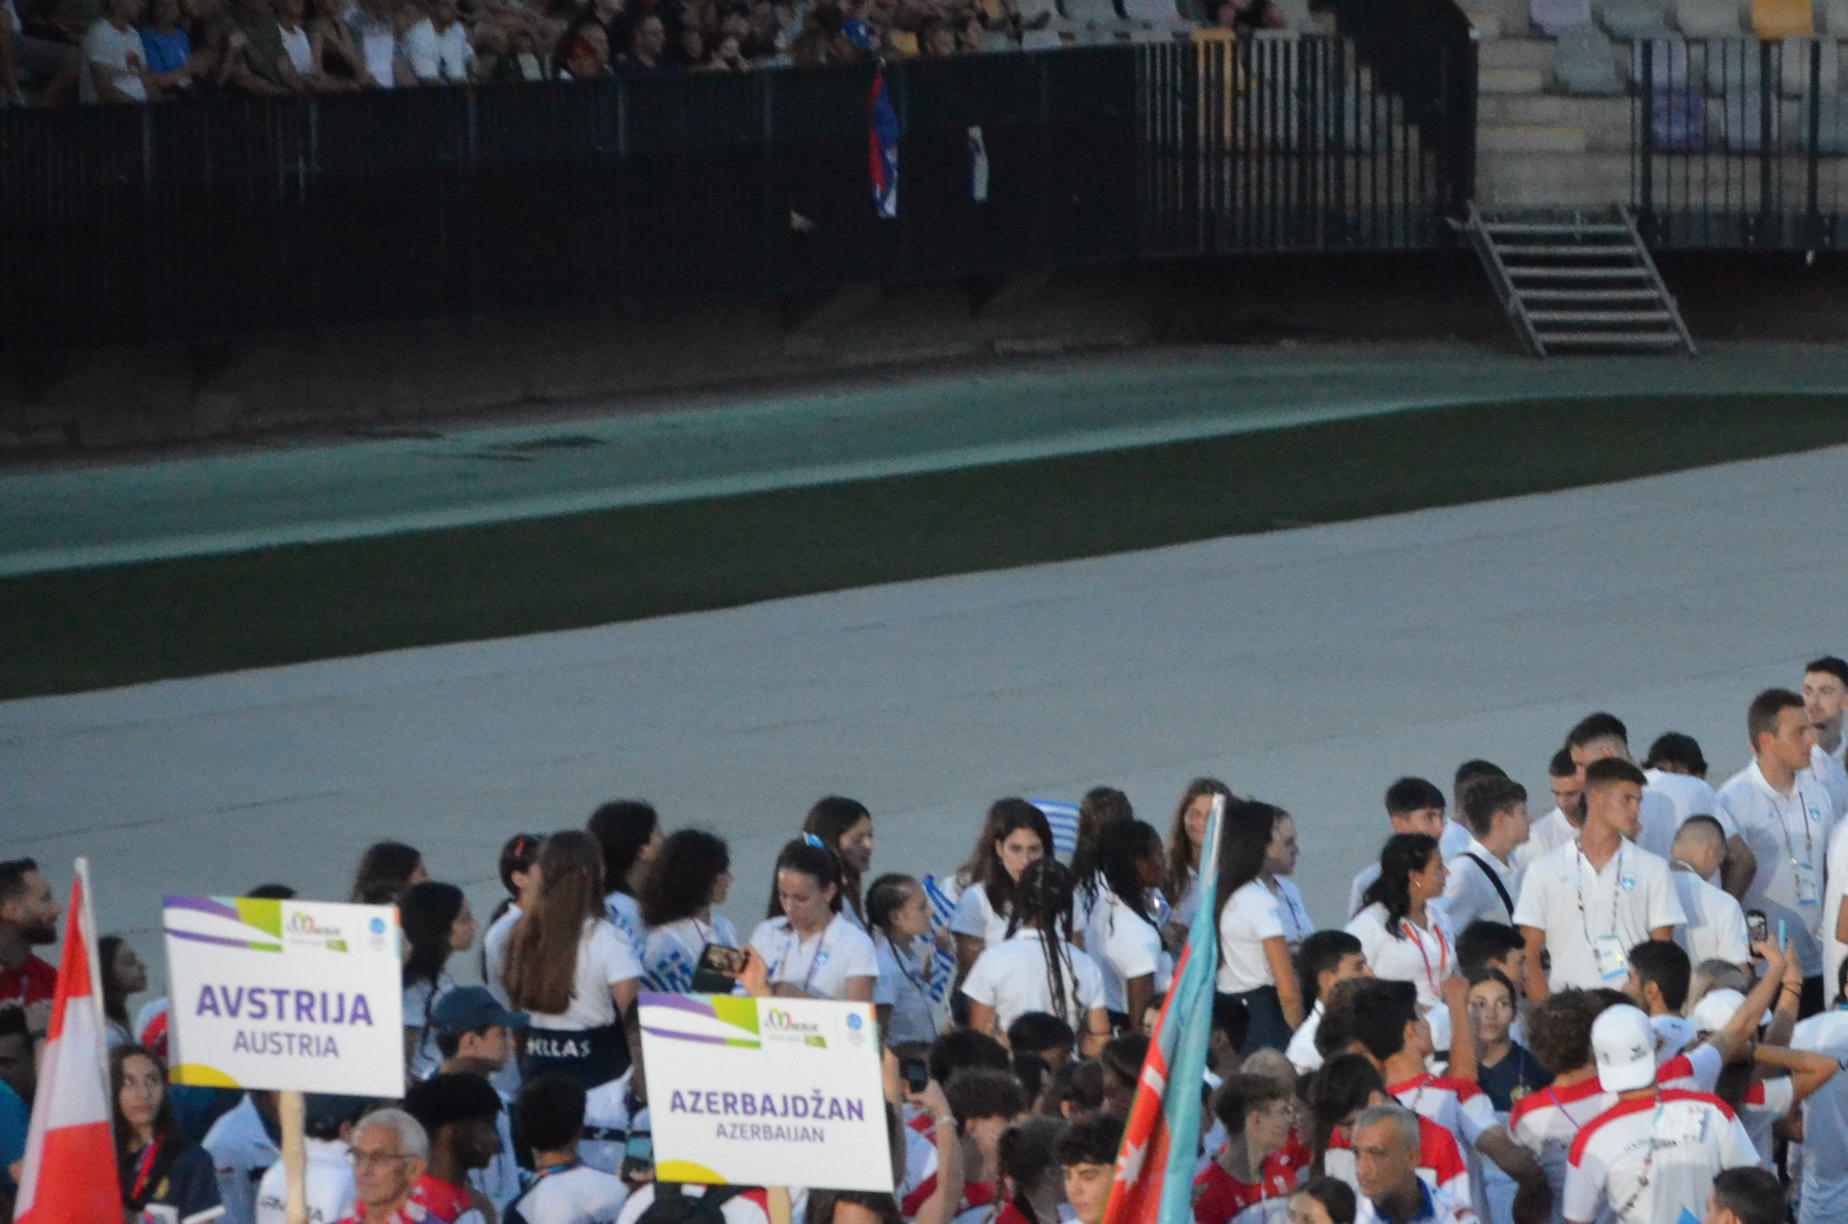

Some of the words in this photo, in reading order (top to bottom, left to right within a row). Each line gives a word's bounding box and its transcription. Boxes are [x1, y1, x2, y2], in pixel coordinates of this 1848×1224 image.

[195, 984, 374, 1026] AVSTRIJA
[233, 1030, 340, 1058] AUSTRIA
[670, 1088, 865, 1121] AZERBAJDŽAN
[716, 1122, 826, 1143] AZERBAIJAN
